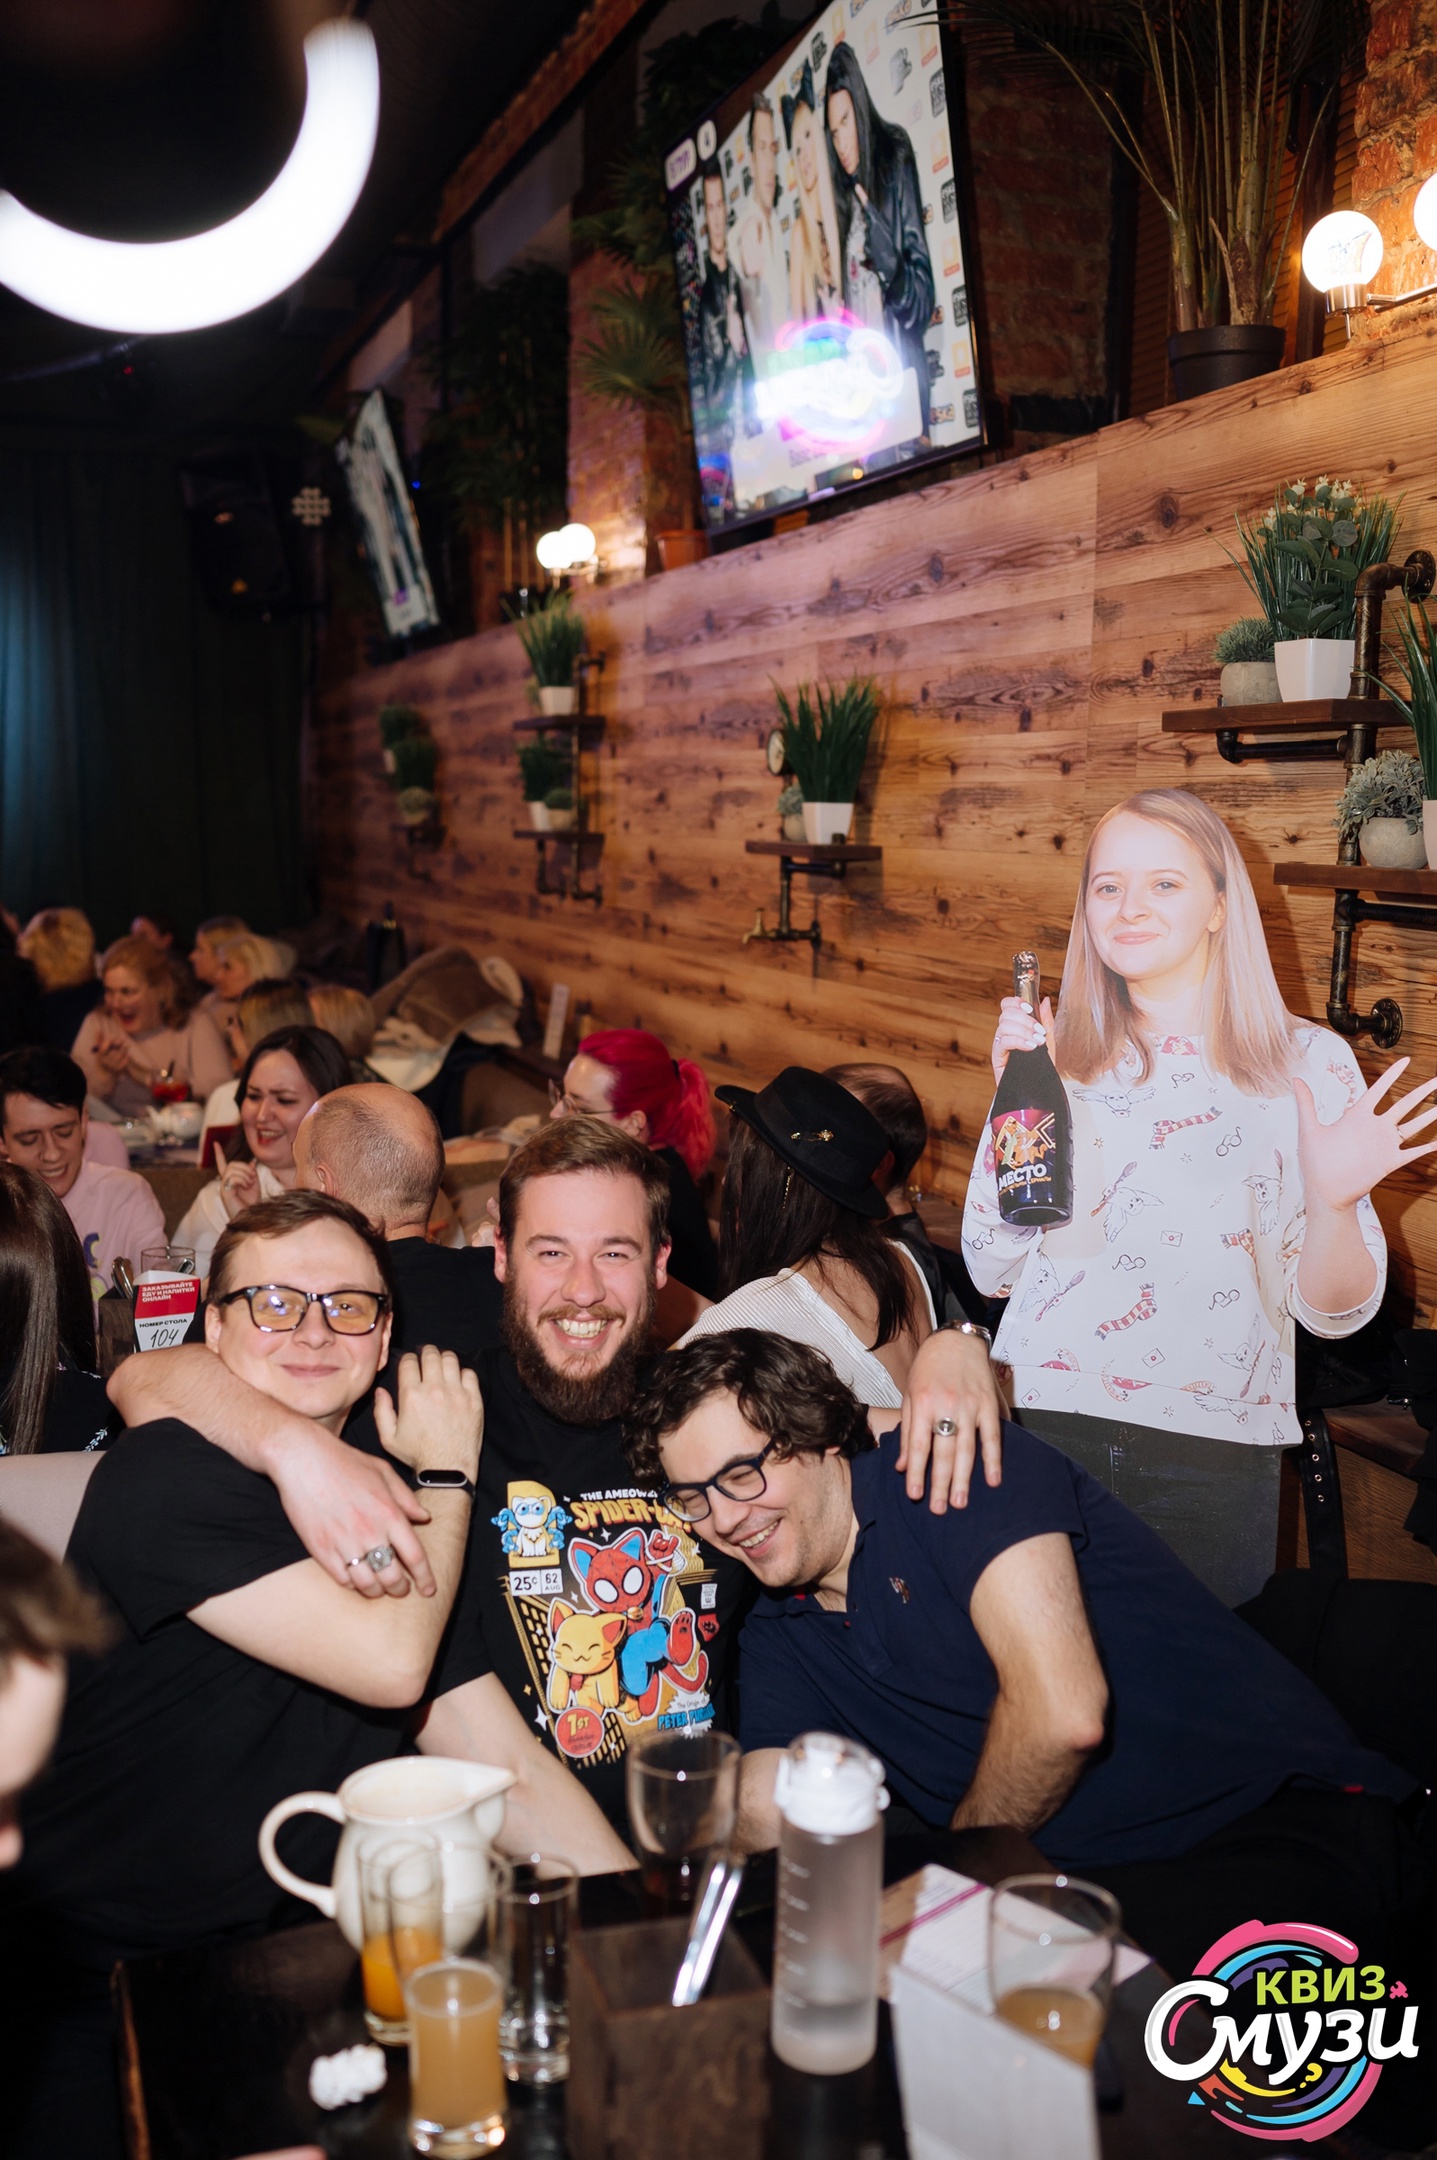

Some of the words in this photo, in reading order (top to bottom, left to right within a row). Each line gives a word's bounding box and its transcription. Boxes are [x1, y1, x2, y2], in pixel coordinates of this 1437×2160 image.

[998, 1163, 1048, 1192] МЕСТО
[142, 1282, 193, 1292] ЗАКАЗЫВАЙТЕ
[162, 1287, 195, 1295] НАПИТКИ
[142, 1295, 171, 1303] ОНЛАЙН
[150, 1328, 179, 1348] 104
[580, 1489, 603, 1501] THE
[545, 1573, 558, 1584] 62
[657, 1711, 689, 1731] PETER
